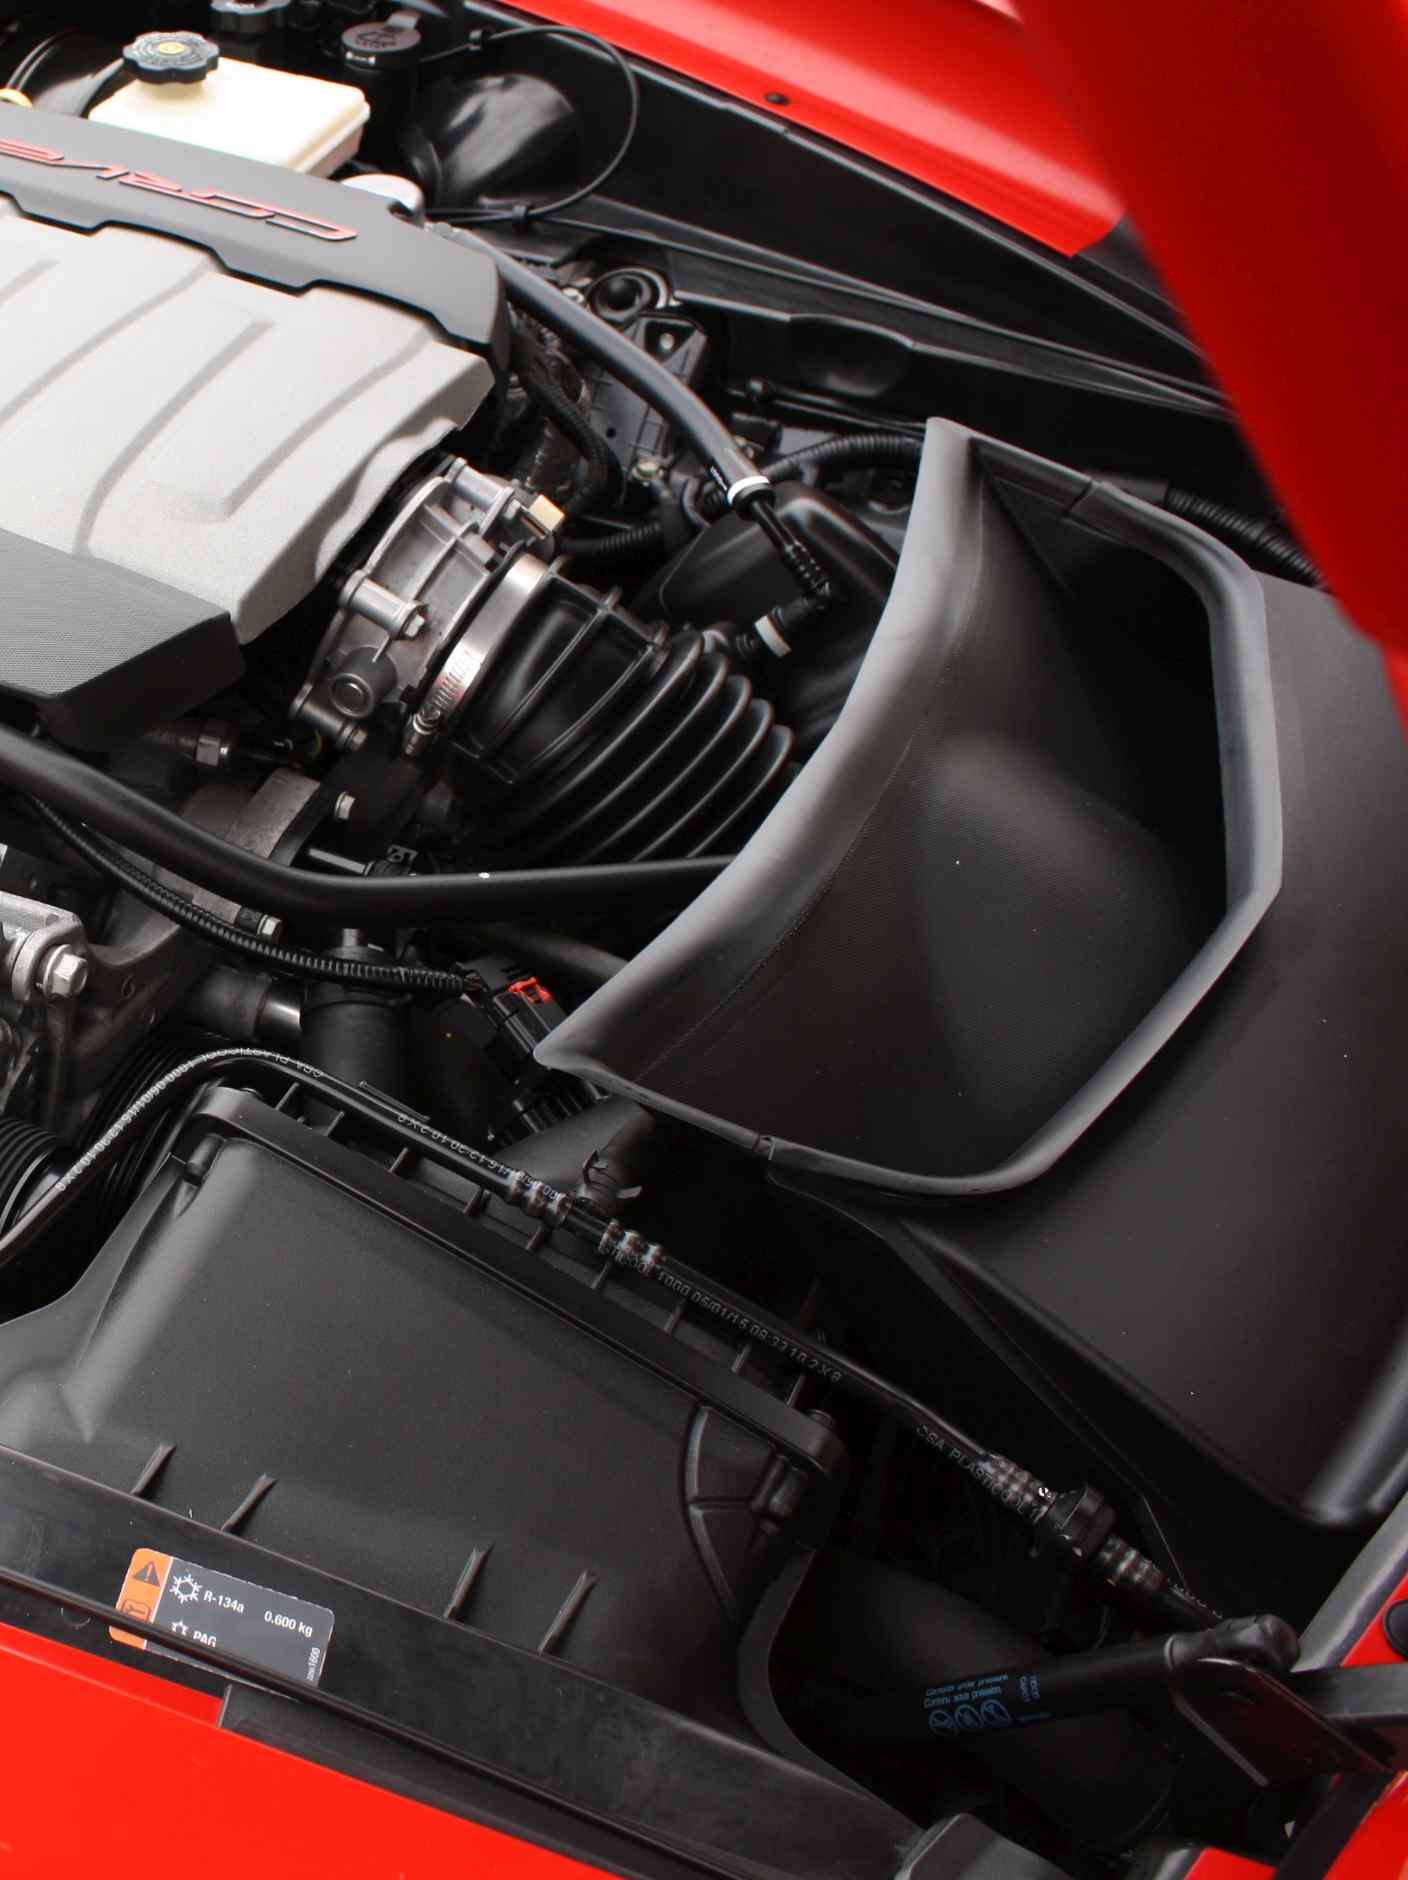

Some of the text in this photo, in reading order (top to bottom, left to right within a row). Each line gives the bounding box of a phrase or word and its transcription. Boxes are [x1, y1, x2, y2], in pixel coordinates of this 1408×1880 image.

[201, 1589, 314, 1638] R-134a 0.600 kg
[191, 1629, 218, 1648] PAG
